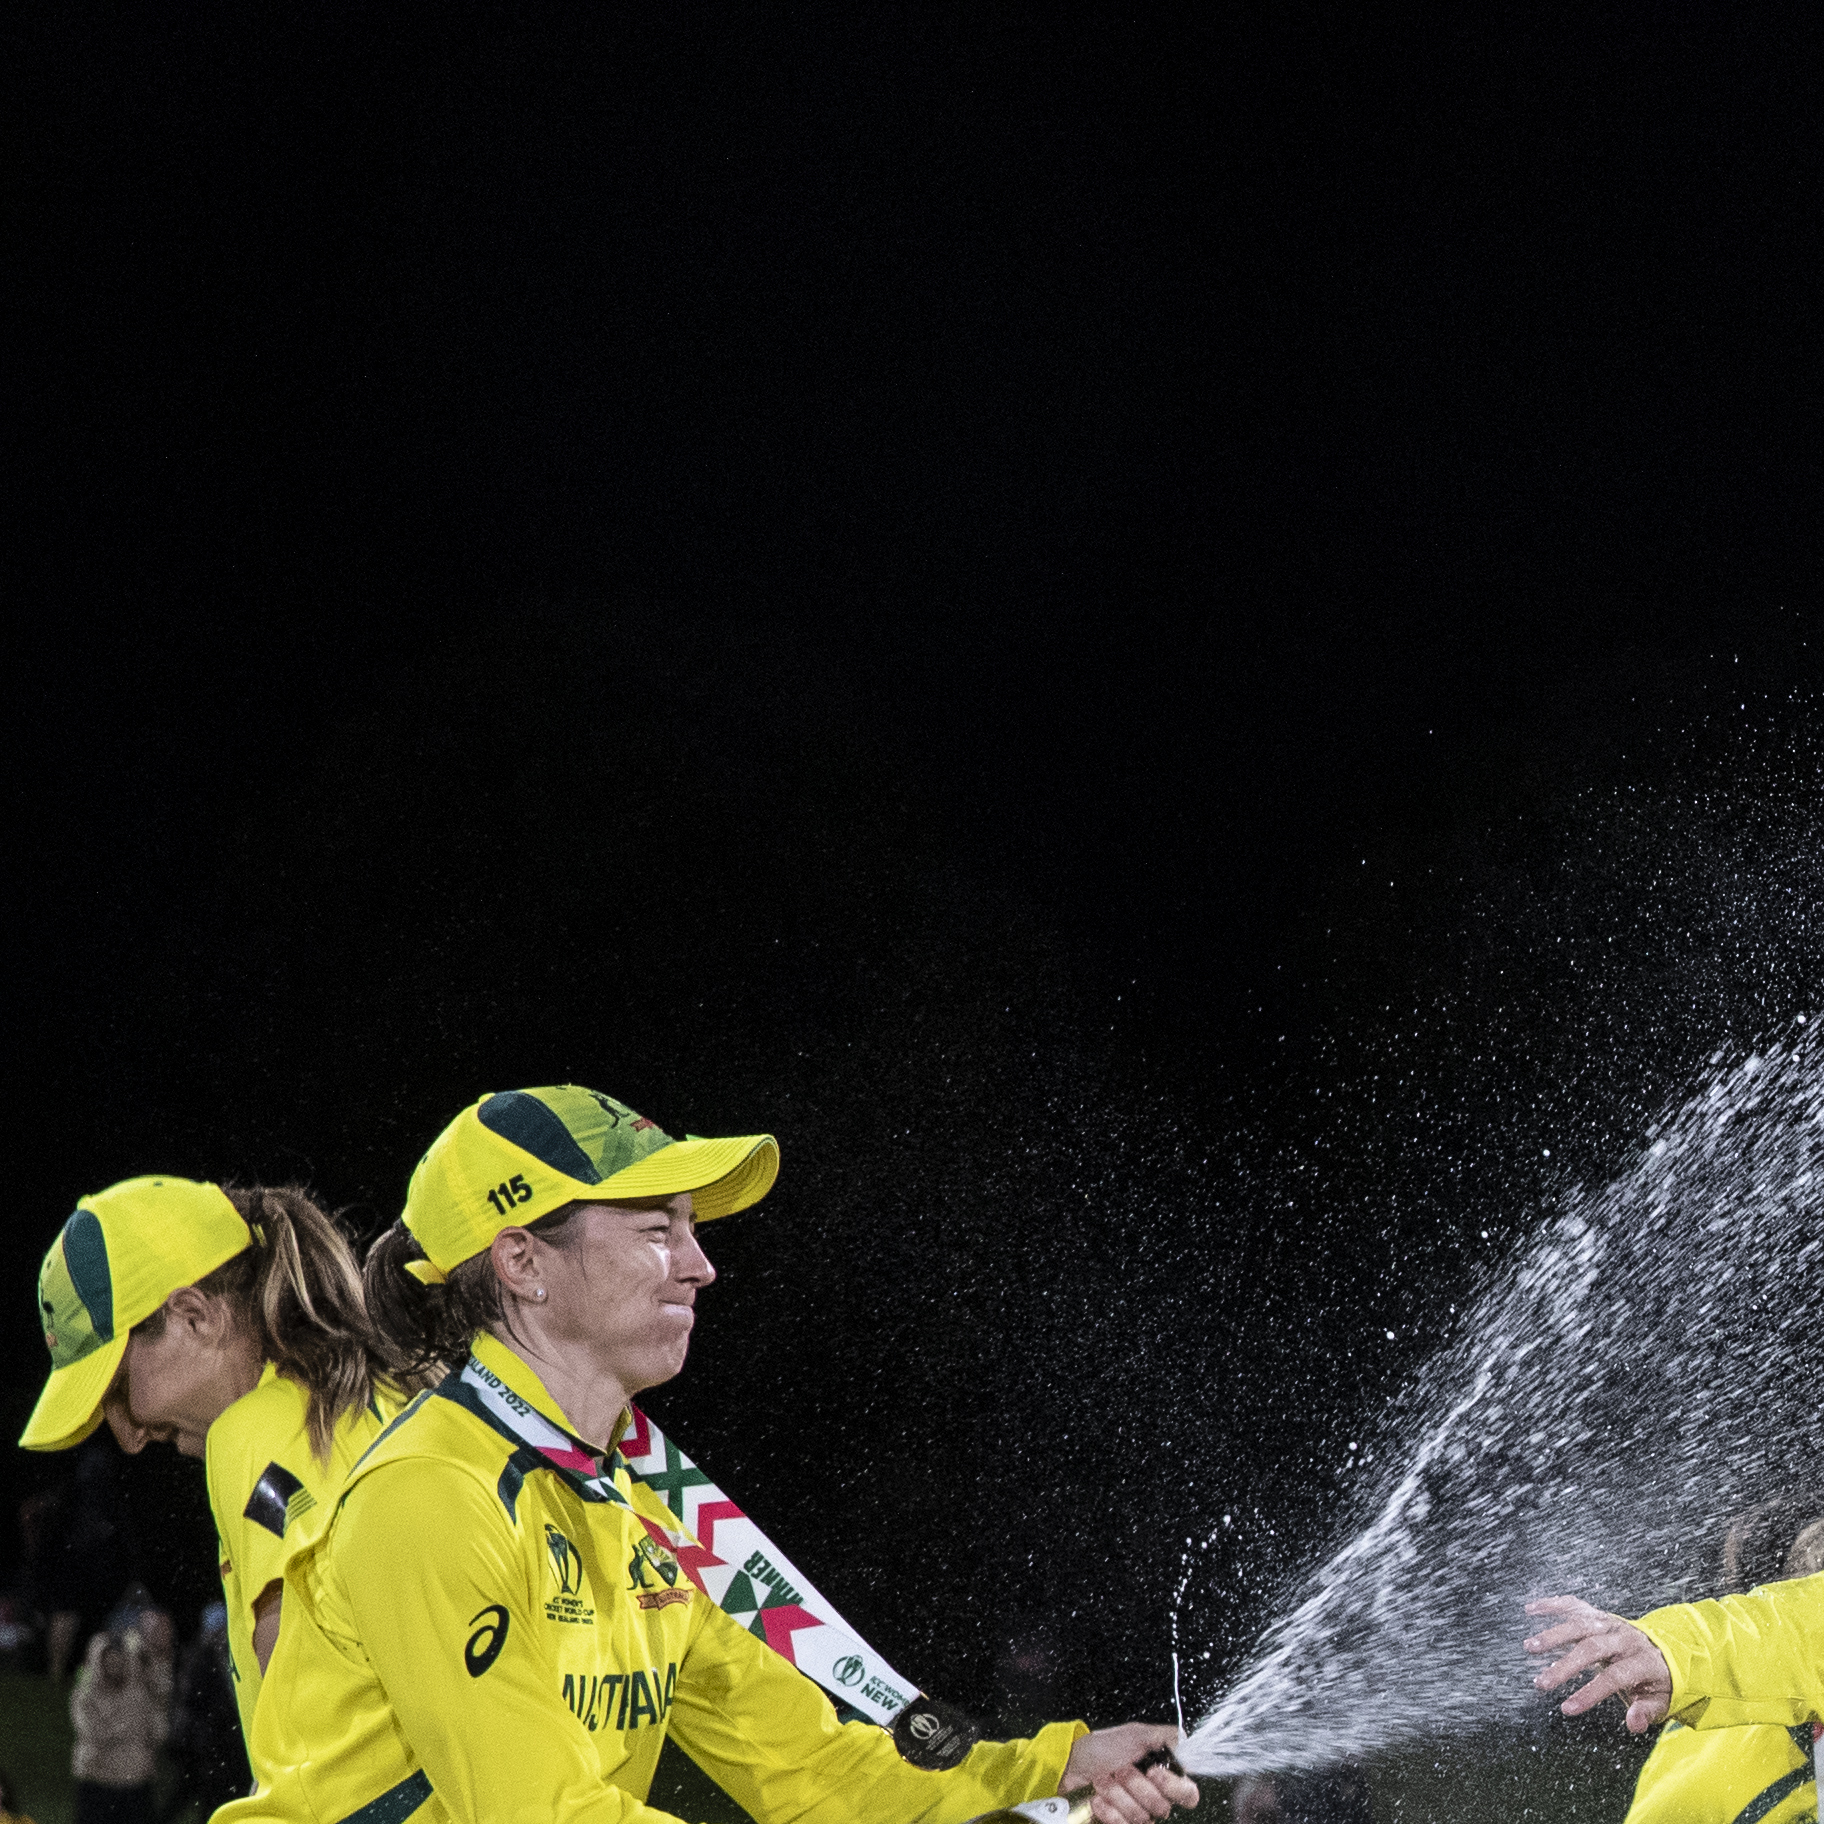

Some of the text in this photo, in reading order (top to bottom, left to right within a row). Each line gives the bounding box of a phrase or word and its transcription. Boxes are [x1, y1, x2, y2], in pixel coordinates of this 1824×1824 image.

[486, 1172, 534, 1216] 115
[497, 1383, 532, 1418] 2022
[743, 1549, 805, 1605] WINNER
[860, 1683, 899, 1711] NEW
